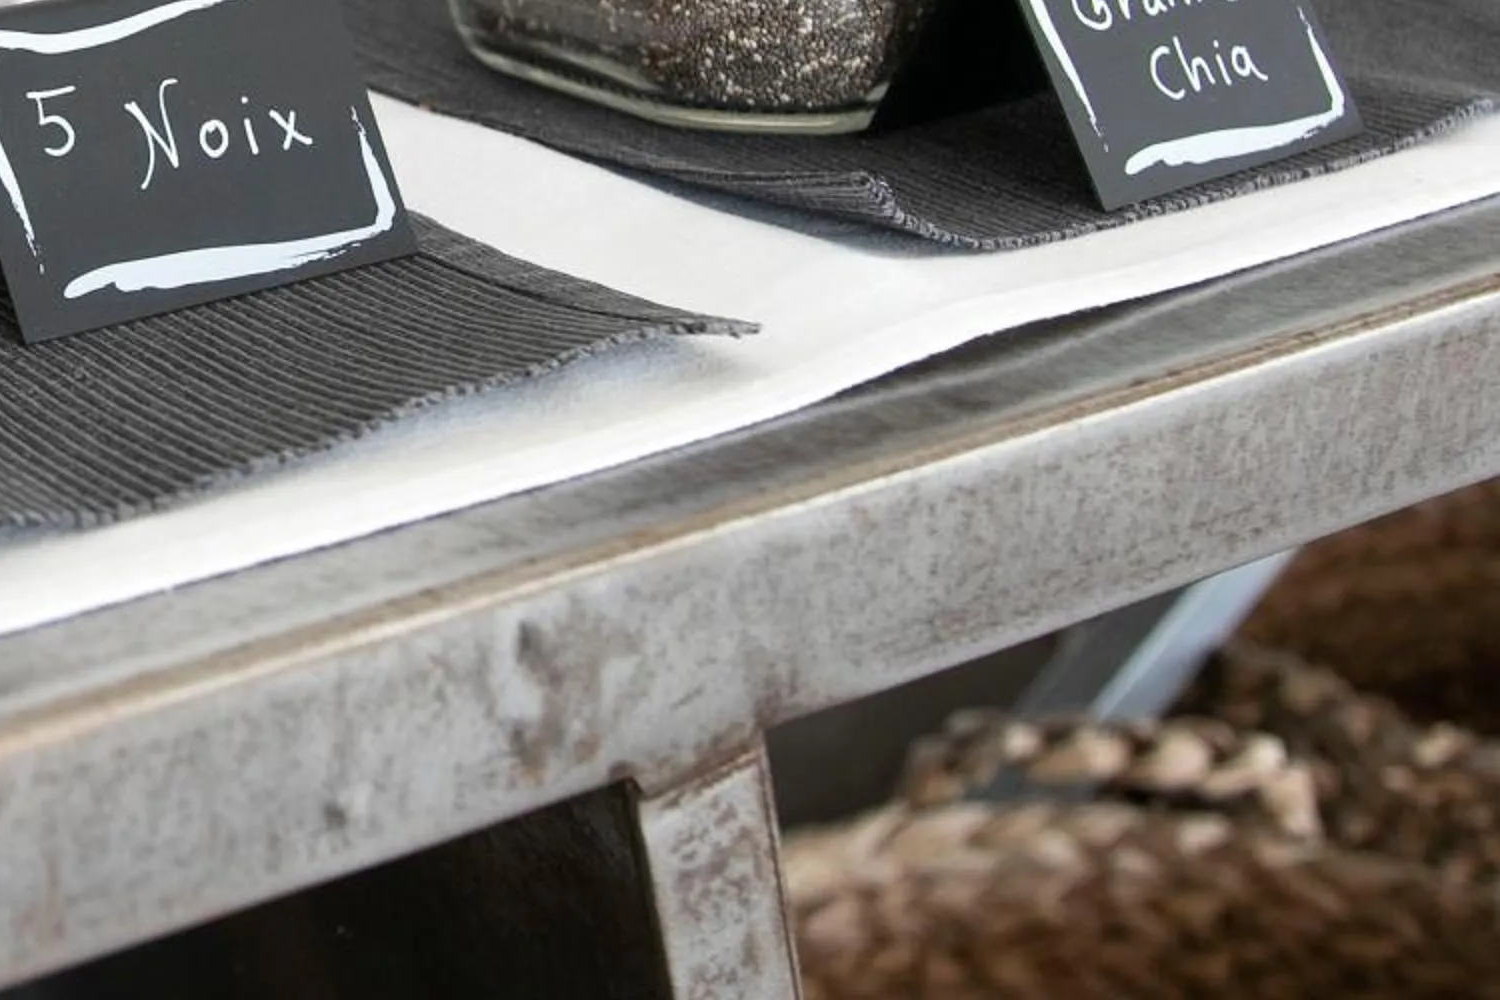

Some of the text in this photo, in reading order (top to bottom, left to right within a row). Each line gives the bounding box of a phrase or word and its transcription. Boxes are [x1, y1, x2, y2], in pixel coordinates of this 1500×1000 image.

[1150, 36, 1269, 101] Chia
[25, 78, 314, 190] 5 Noix
